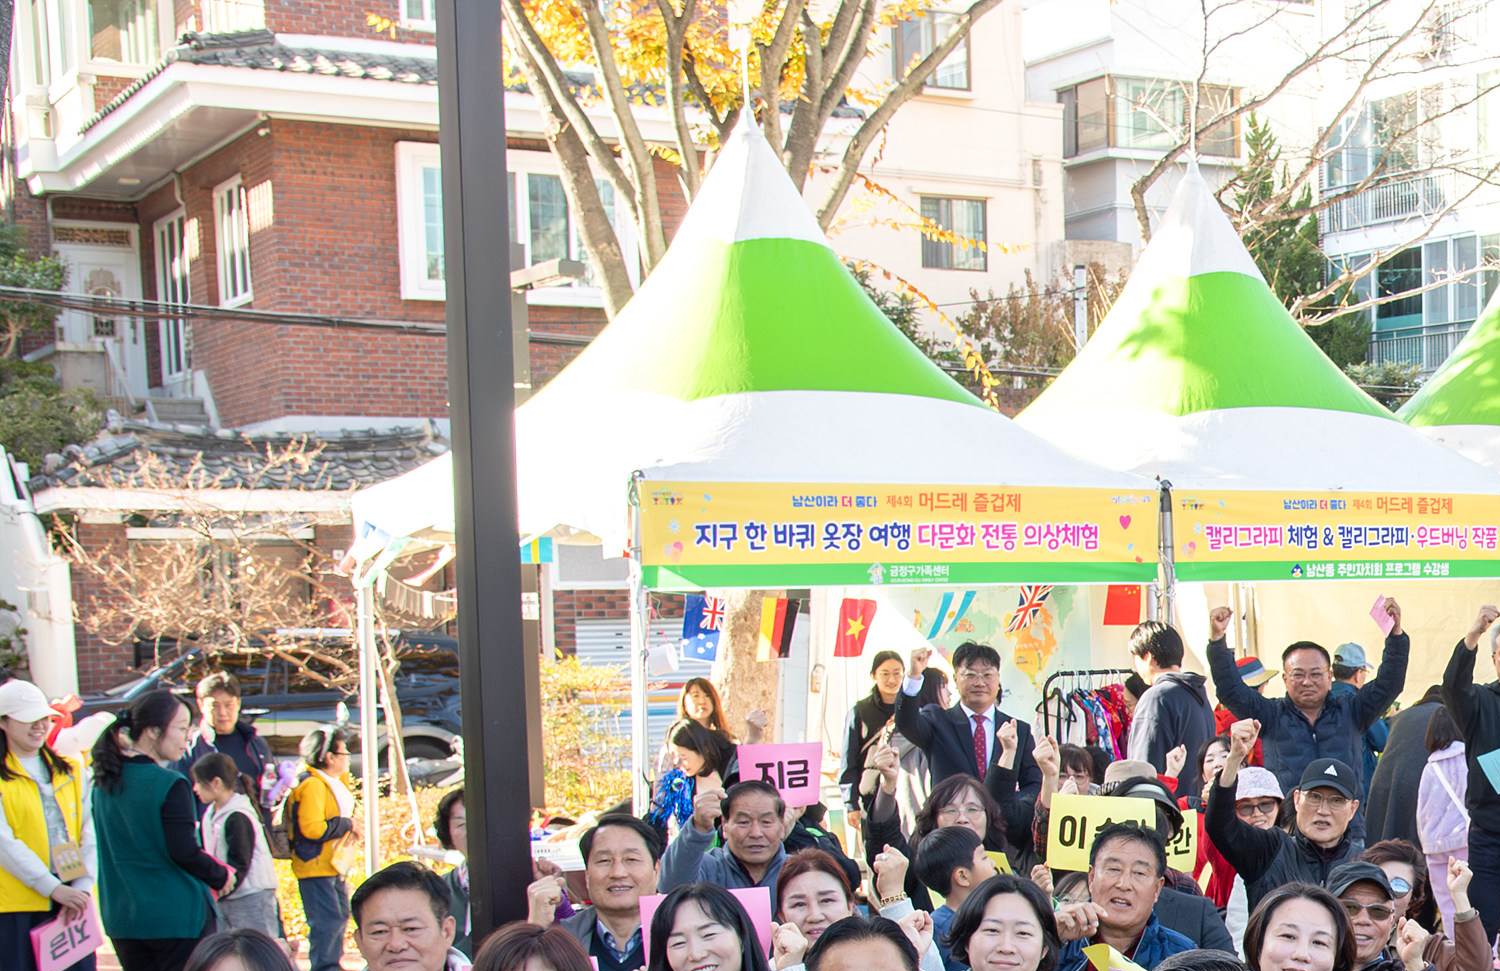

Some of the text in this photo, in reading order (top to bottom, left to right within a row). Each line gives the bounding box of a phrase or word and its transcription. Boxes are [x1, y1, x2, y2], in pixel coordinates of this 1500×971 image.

[792, 495, 838, 508] 남산이라
[841, 496, 852, 508] 더
[919, 492, 968, 512] 머드레
[972, 493, 1022, 513] 즐겁제
[1283, 499, 1317, 510] 남산이라
[1319, 500, 1328, 510] 더
[1376, 497, 1413, 514] 머드레
[1416, 497, 1453, 514] 즐겁제
[695, 522, 1099, 551] 지구 한 바퀴 옷장 여행 다문화 전통 의상체험
[1206, 525, 1283, 550] 캘리그라피
[1287, 524, 1318, 549] 체험
[1323, 527, 1334, 546] &
[1472, 527, 1497, 549] 작품
[1306, 564, 1335, 577] 남산동
[755, 760, 809, 789] 지금
[1059, 815, 1087, 849] 이
